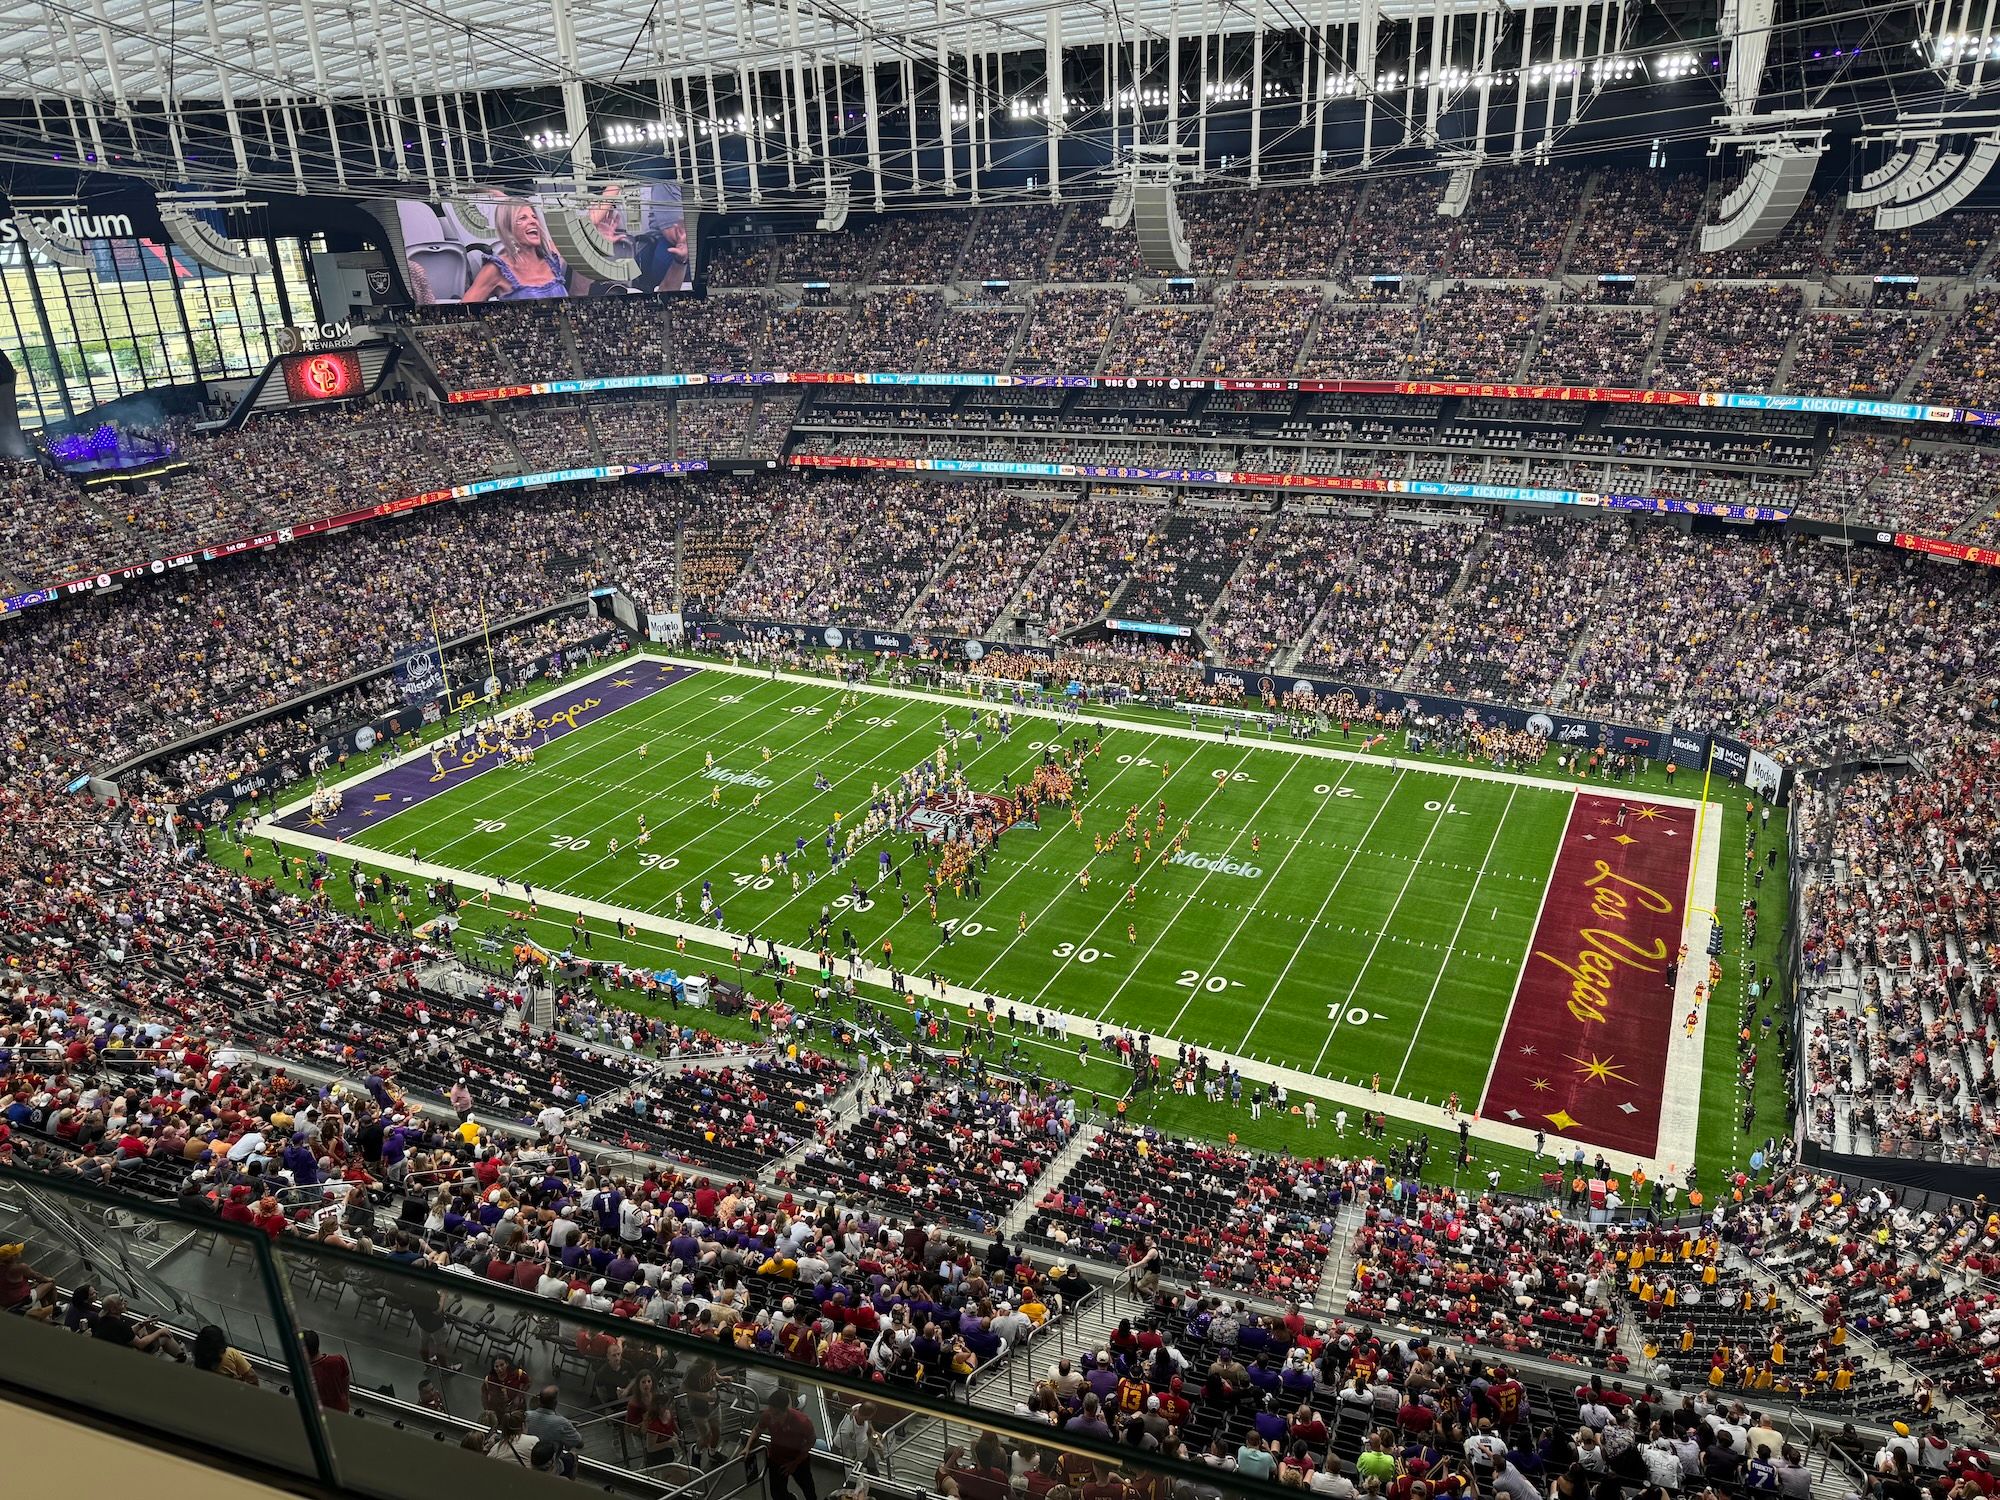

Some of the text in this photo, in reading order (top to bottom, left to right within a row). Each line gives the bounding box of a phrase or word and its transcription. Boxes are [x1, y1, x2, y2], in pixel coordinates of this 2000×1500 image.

[0, 207, 133, 241] sadium
[301, 322, 352, 341] MGM
[604, 377, 641, 389] KICKOFF
[642, 376, 675, 387] CLASSIC
[1105, 379, 1124, 388] USC
[1738, 398, 1760, 406] Modelo
[1765, 396, 1798, 410] Vegas
[1802, 399, 1856, 413] KICKOFF
[1857, 402, 1910, 416] CLASSIC
[982, 462, 1015, 472] KICKOFF
[1016, 464, 1050, 474] CLASSIC
[522, 472, 558, 486] KICKOFF
[560, 469, 597, 480] CLASSIC
[1443, 484, 1470, 496] Vegas
[1472, 486, 1517, 499] KICKOFF
[1519, 489, 1563, 502] CLASSIC
[278, 528, 292, 542] 25
[1878, 534, 1890, 542] CC
[68, 582, 94, 594] USC
[168, 555, 192, 568] LSU
[874, 635, 900, 647] Modelo
[400, 672, 442, 694] Allstate
[865, 716, 899, 728] 30
[1672, 737, 1700, 754] Modelo
[1116, 754, 1152, 767] 40
[1725, 748, 1746, 764] MGM
[702, 767, 774, 790] Modelo
[1752, 761, 1777, 788] Modelo
[1312, 784, 1356, 798] 20
[1423, 800, 1461, 814] 10
[476, 818, 507, 834] 10
[551, 836, 592, 852] 20
[638, 853, 680, 871] 30
[1168, 850, 1264, 880] Modelo
[732, 872, 774, 891] 40
[1584, 859, 1674, 920] Las
[1052, 942, 1102, 964] 30
[1174, 969, 1230, 994] 20
[1535, 928, 1668, 1024] Vegas
[1326, 1002, 1371, 1026] 10
[604, 1198, 611, 1213] 1
[788, 1334, 800, 1353] 7
[1121, 1386, 1142, 1410] 13
[1756, 1472, 1769, 1488] 7
